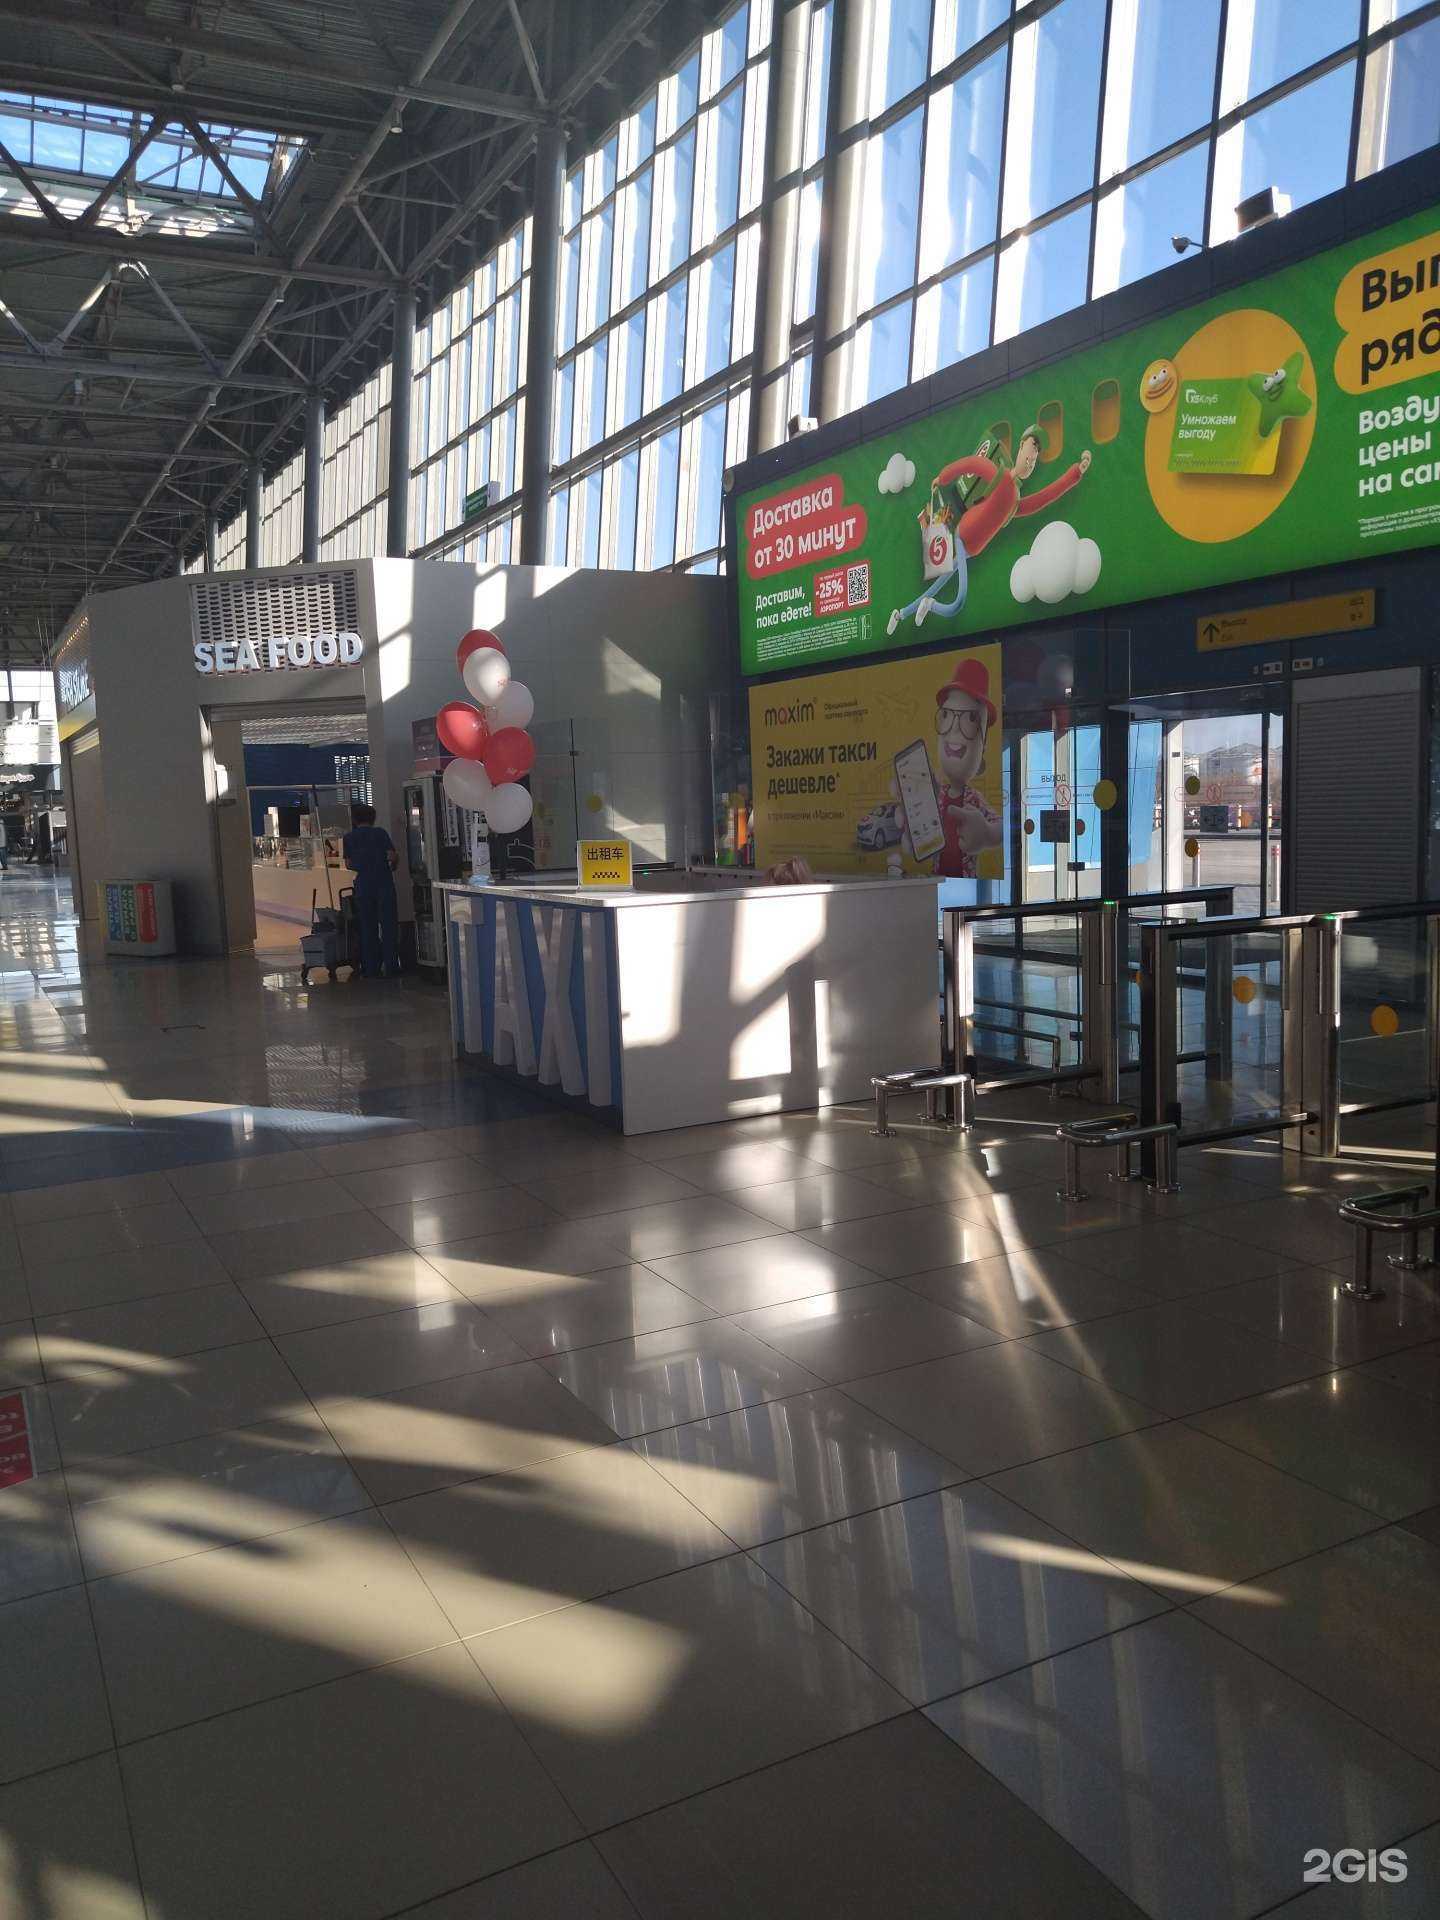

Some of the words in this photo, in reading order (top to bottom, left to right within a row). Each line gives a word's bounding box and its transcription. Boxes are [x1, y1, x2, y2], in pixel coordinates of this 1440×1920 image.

[1181, 414, 1237, 426] Умножаем
[1178, 428, 1217, 441] выгоду
[1359, 431, 1432, 467] цены
[1359, 472, 1393, 497] на
[753, 486, 833, 538] Доставка
[754, 546, 773, 569] от
[775, 534, 794, 562] 30
[798, 517, 857, 556] минут
[755, 585, 806, 612] Доставим,
[815, 579, 845, 599] -25%
[756, 609, 780, 629] пока
[780, 601, 812, 624] едете!
[193, 639, 260, 673] SEA
[267, 632, 363, 668] FOOD
[764, 698, 815, 727] maxim
[766, 745, 825, 768] Закажи
[828, 741, 878, 763] такси
[587, 847, 624, 861] 出租车
[450, 894, 613, 1107] TAXI
